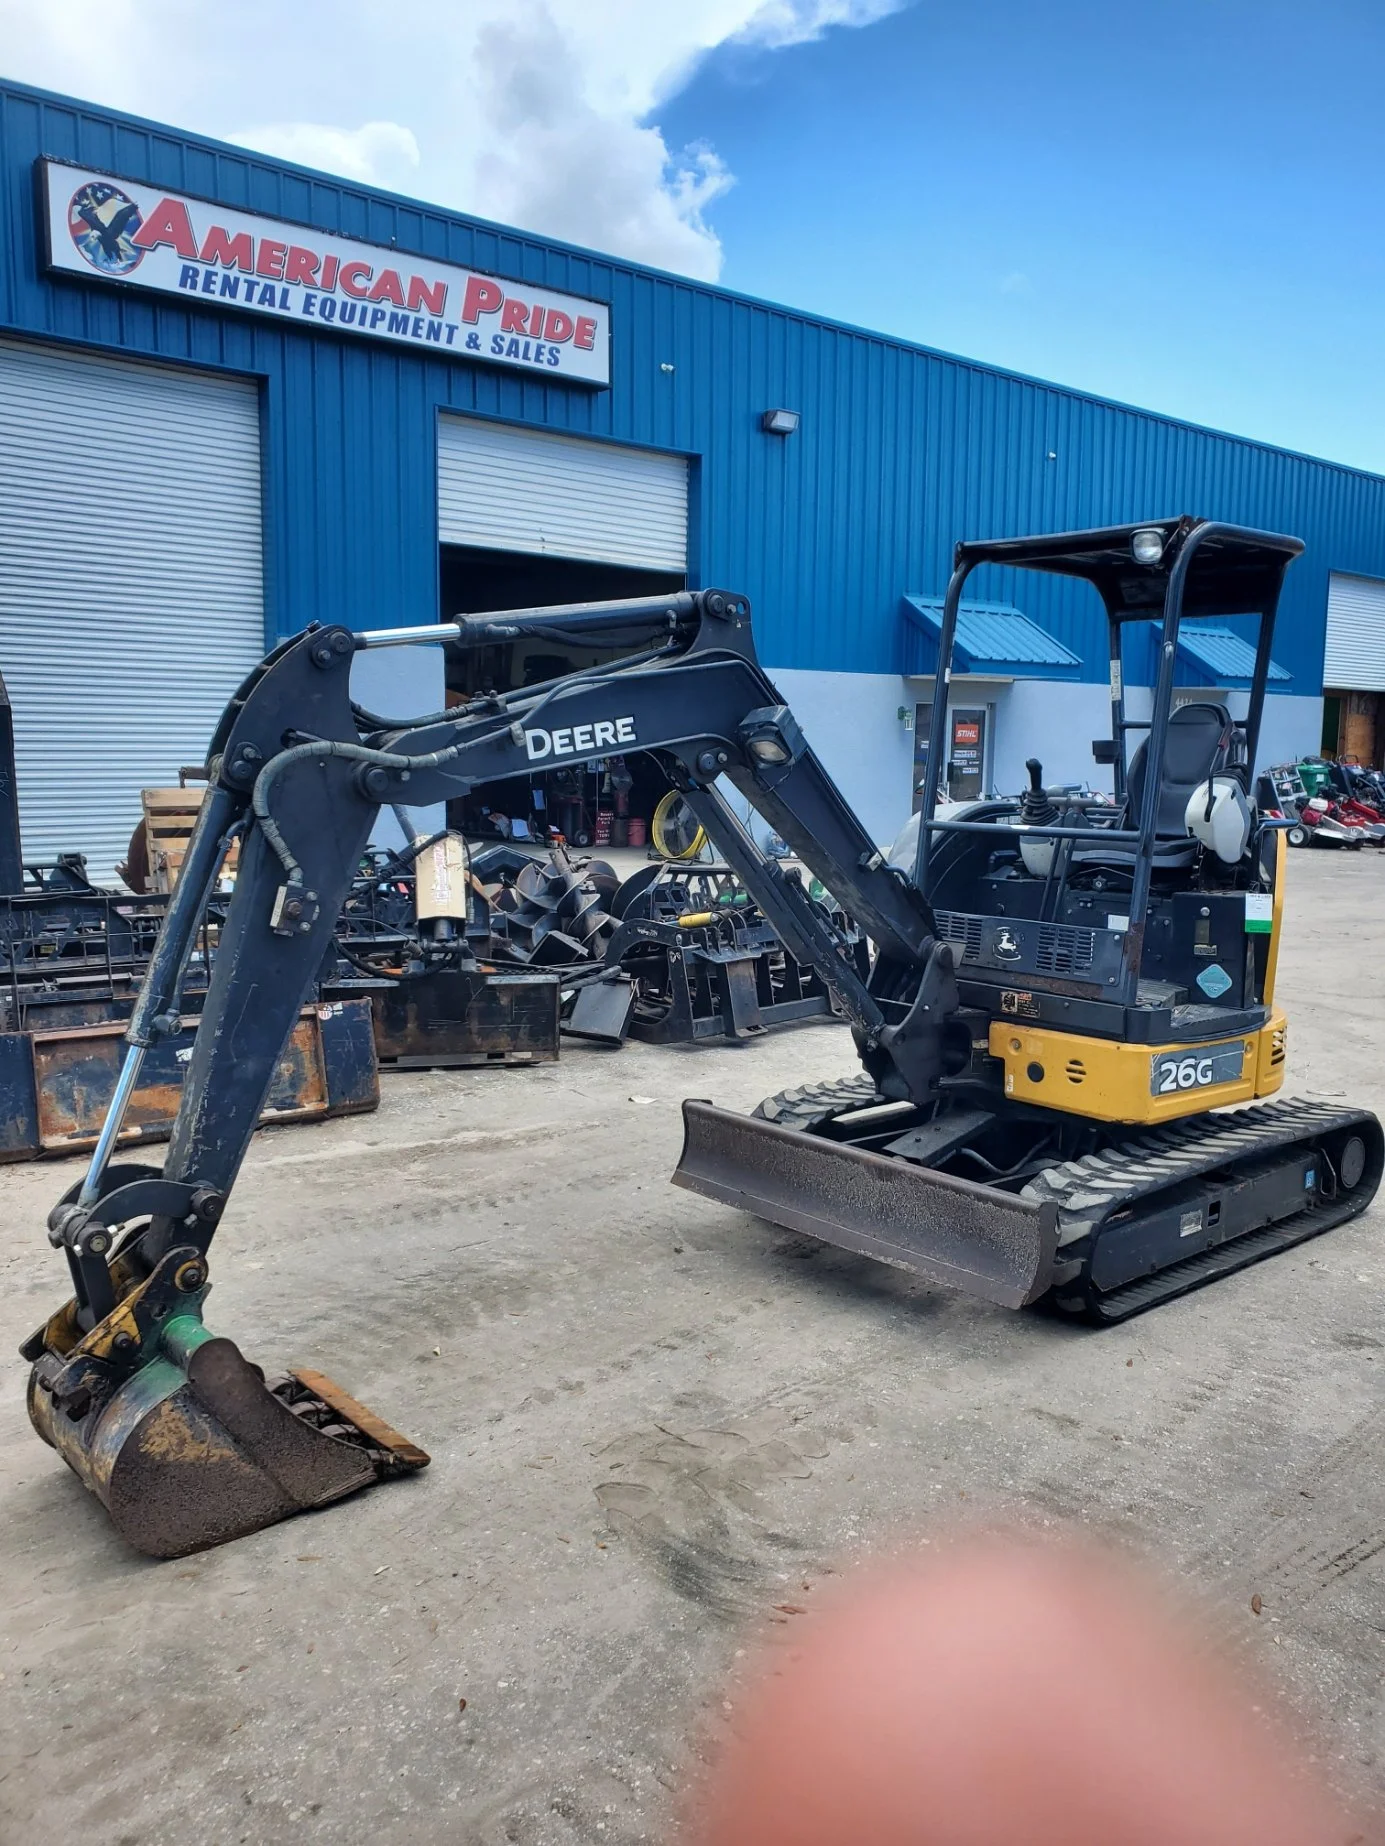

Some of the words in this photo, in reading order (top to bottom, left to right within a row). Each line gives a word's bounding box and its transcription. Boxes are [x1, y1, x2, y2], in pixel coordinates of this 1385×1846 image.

[131, 197, 448, 317] AMERICAN
[461, 275, 597, 350] PRIDE
[179, 265, 291, 311] RENTAL
[302, 292, 459, 345] EQUIPMENT
[465, 331, 482, 351] &
[490, 333, 561, 367] SALES
[525, 717, 636, 760] DEERE
[956, 730, 977, 738] STIHL
[1160, 1058, 1213, 1092] 26G
